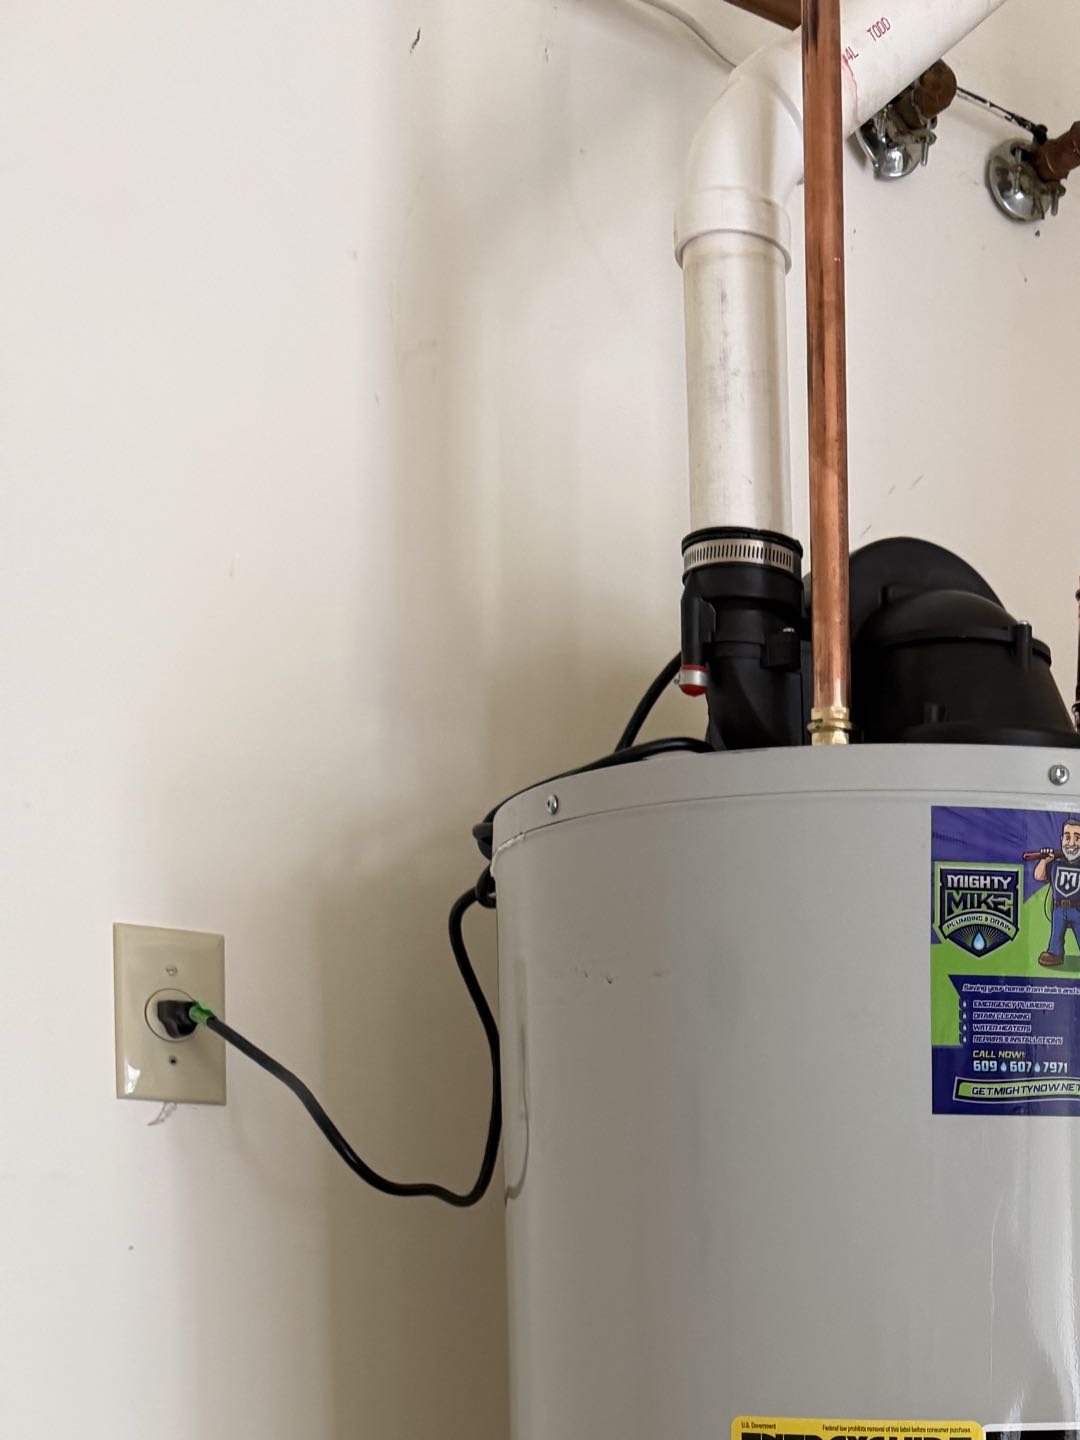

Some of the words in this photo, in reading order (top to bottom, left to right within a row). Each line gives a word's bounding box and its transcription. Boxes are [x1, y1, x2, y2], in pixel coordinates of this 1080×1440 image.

[866, 17, 891, 42] TODD
[946, 874, 1013, 890] MIGHTY
[946, 890, 1014, 917] MIKE
[946, 915, 983, 930] PLUMBING
[989, 918, 1013, 932] DRAIN
[962, 983, 987, 993] Saving
[987, 984, 1003, 993] your
[1004, 984, 1025, 993] home
[1025, 985, 1044, 994] from
[1043, 985, 1062, 994] leaks
[1062, 987, 1077, 995] and
[972, 1000, 1016, 1009] EMERGENCY
[1016, 1000, 1054, 1010] PLUMBING
[972, 1012, 997, 1021] DRAIN
[997, 1012, 1032, 1021] CLEANING
[972, 1024, 1000, 1032] WATER
[1000, 1024, 1032, 1033] HEATERS
[972, 1035, 1004, 1044] REPAIRS
[1009, 1035, 1063, 1045] INSTALLATIONS
[972, 1050, 996, 1058] CALL
[998, 1050, 1025, 1059] NOW!
[973, 1060, 998, 1072] 609
[1009, 1060, 1032, 1073] 607
[1043, 1061, 1068, 1074] 7971
